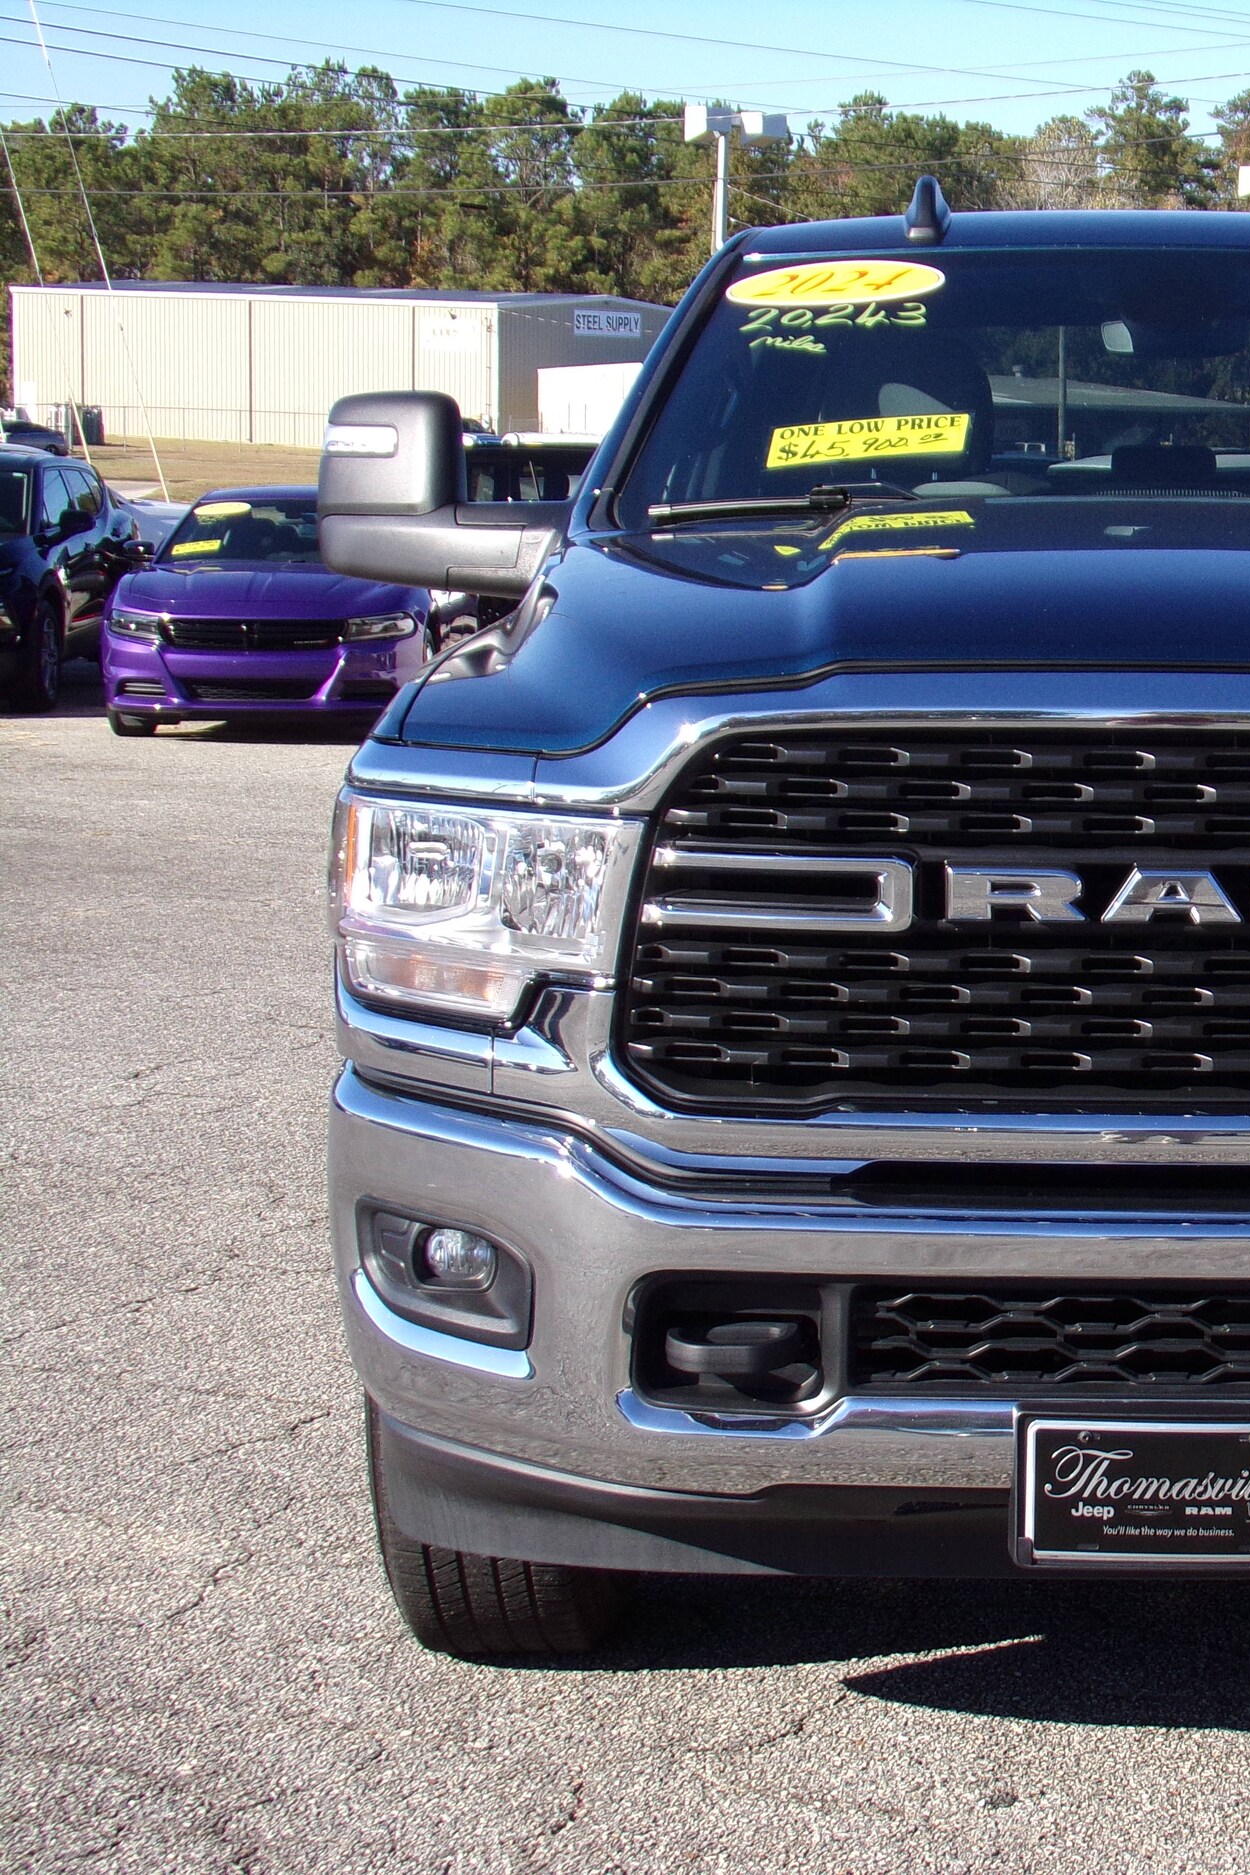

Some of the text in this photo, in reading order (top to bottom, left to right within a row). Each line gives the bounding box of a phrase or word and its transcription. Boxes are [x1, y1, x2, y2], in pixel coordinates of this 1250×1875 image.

[752, 268, 913, 298] 2024
[575, 313, 640, 333] STEEL SUPPLY
[779, 415, 962, 441] ONE LOW PRICE
[1070, 1501, 1115, 1521] Jeep
[1185, 1506, 1233, 1515] RAM
[1103, 1525, 1125, 1535] You'll
[1125, 1526, 1141, 1536] like
[1140, 1526, 1155, 1536] the
[1156, 1529, 1173, 1538] way
[1186, 1527, 1198, 1537] do
[1198, 1527, 1235, 1536] business.
